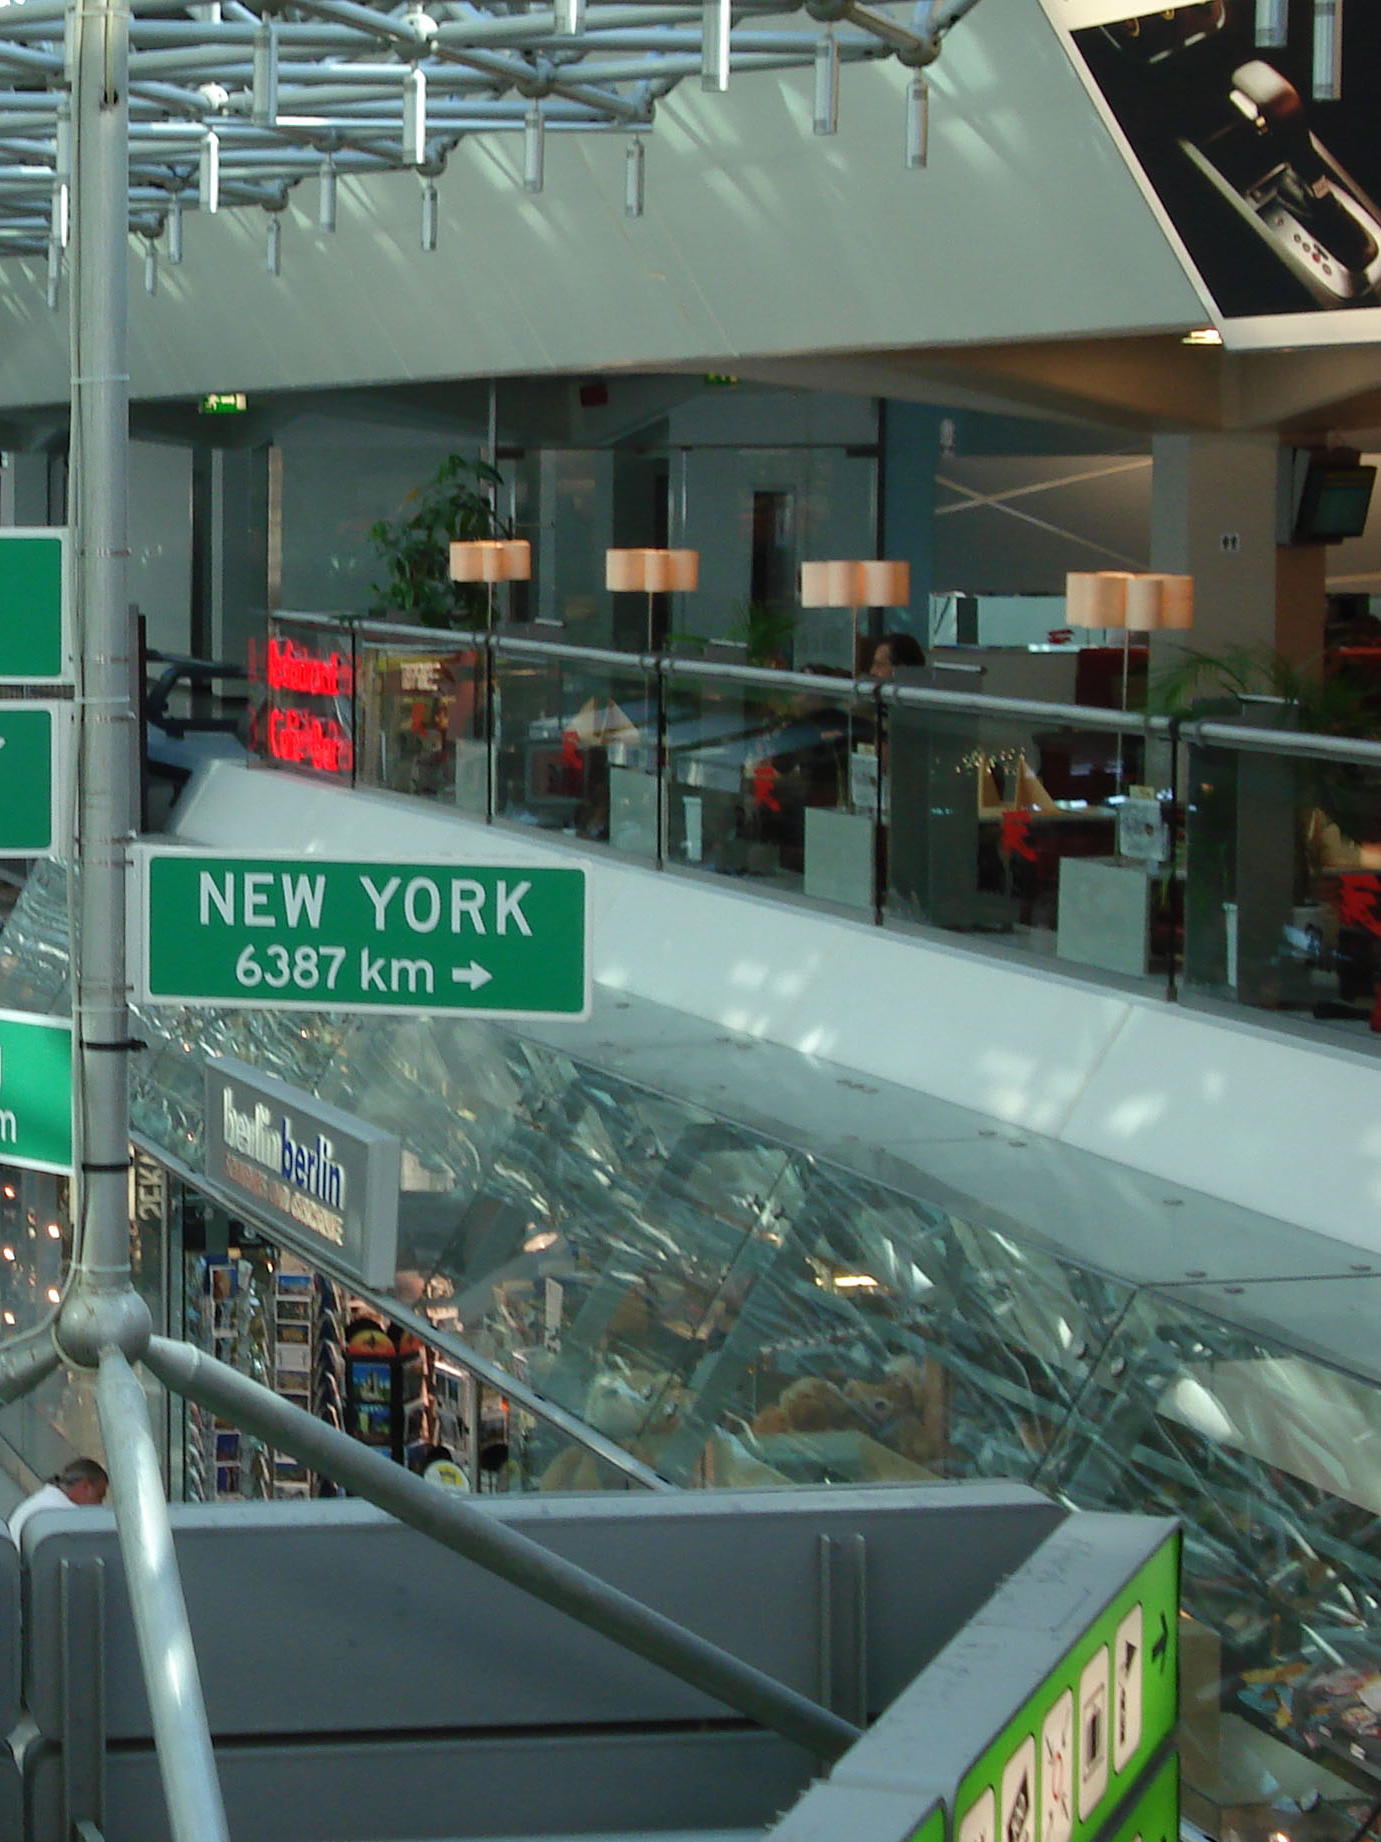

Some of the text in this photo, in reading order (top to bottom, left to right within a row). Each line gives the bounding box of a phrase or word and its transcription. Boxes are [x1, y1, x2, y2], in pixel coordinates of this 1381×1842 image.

[198, 870, 533, 937] NEW YORK
[234, 944, 435, 994] 6387 km
